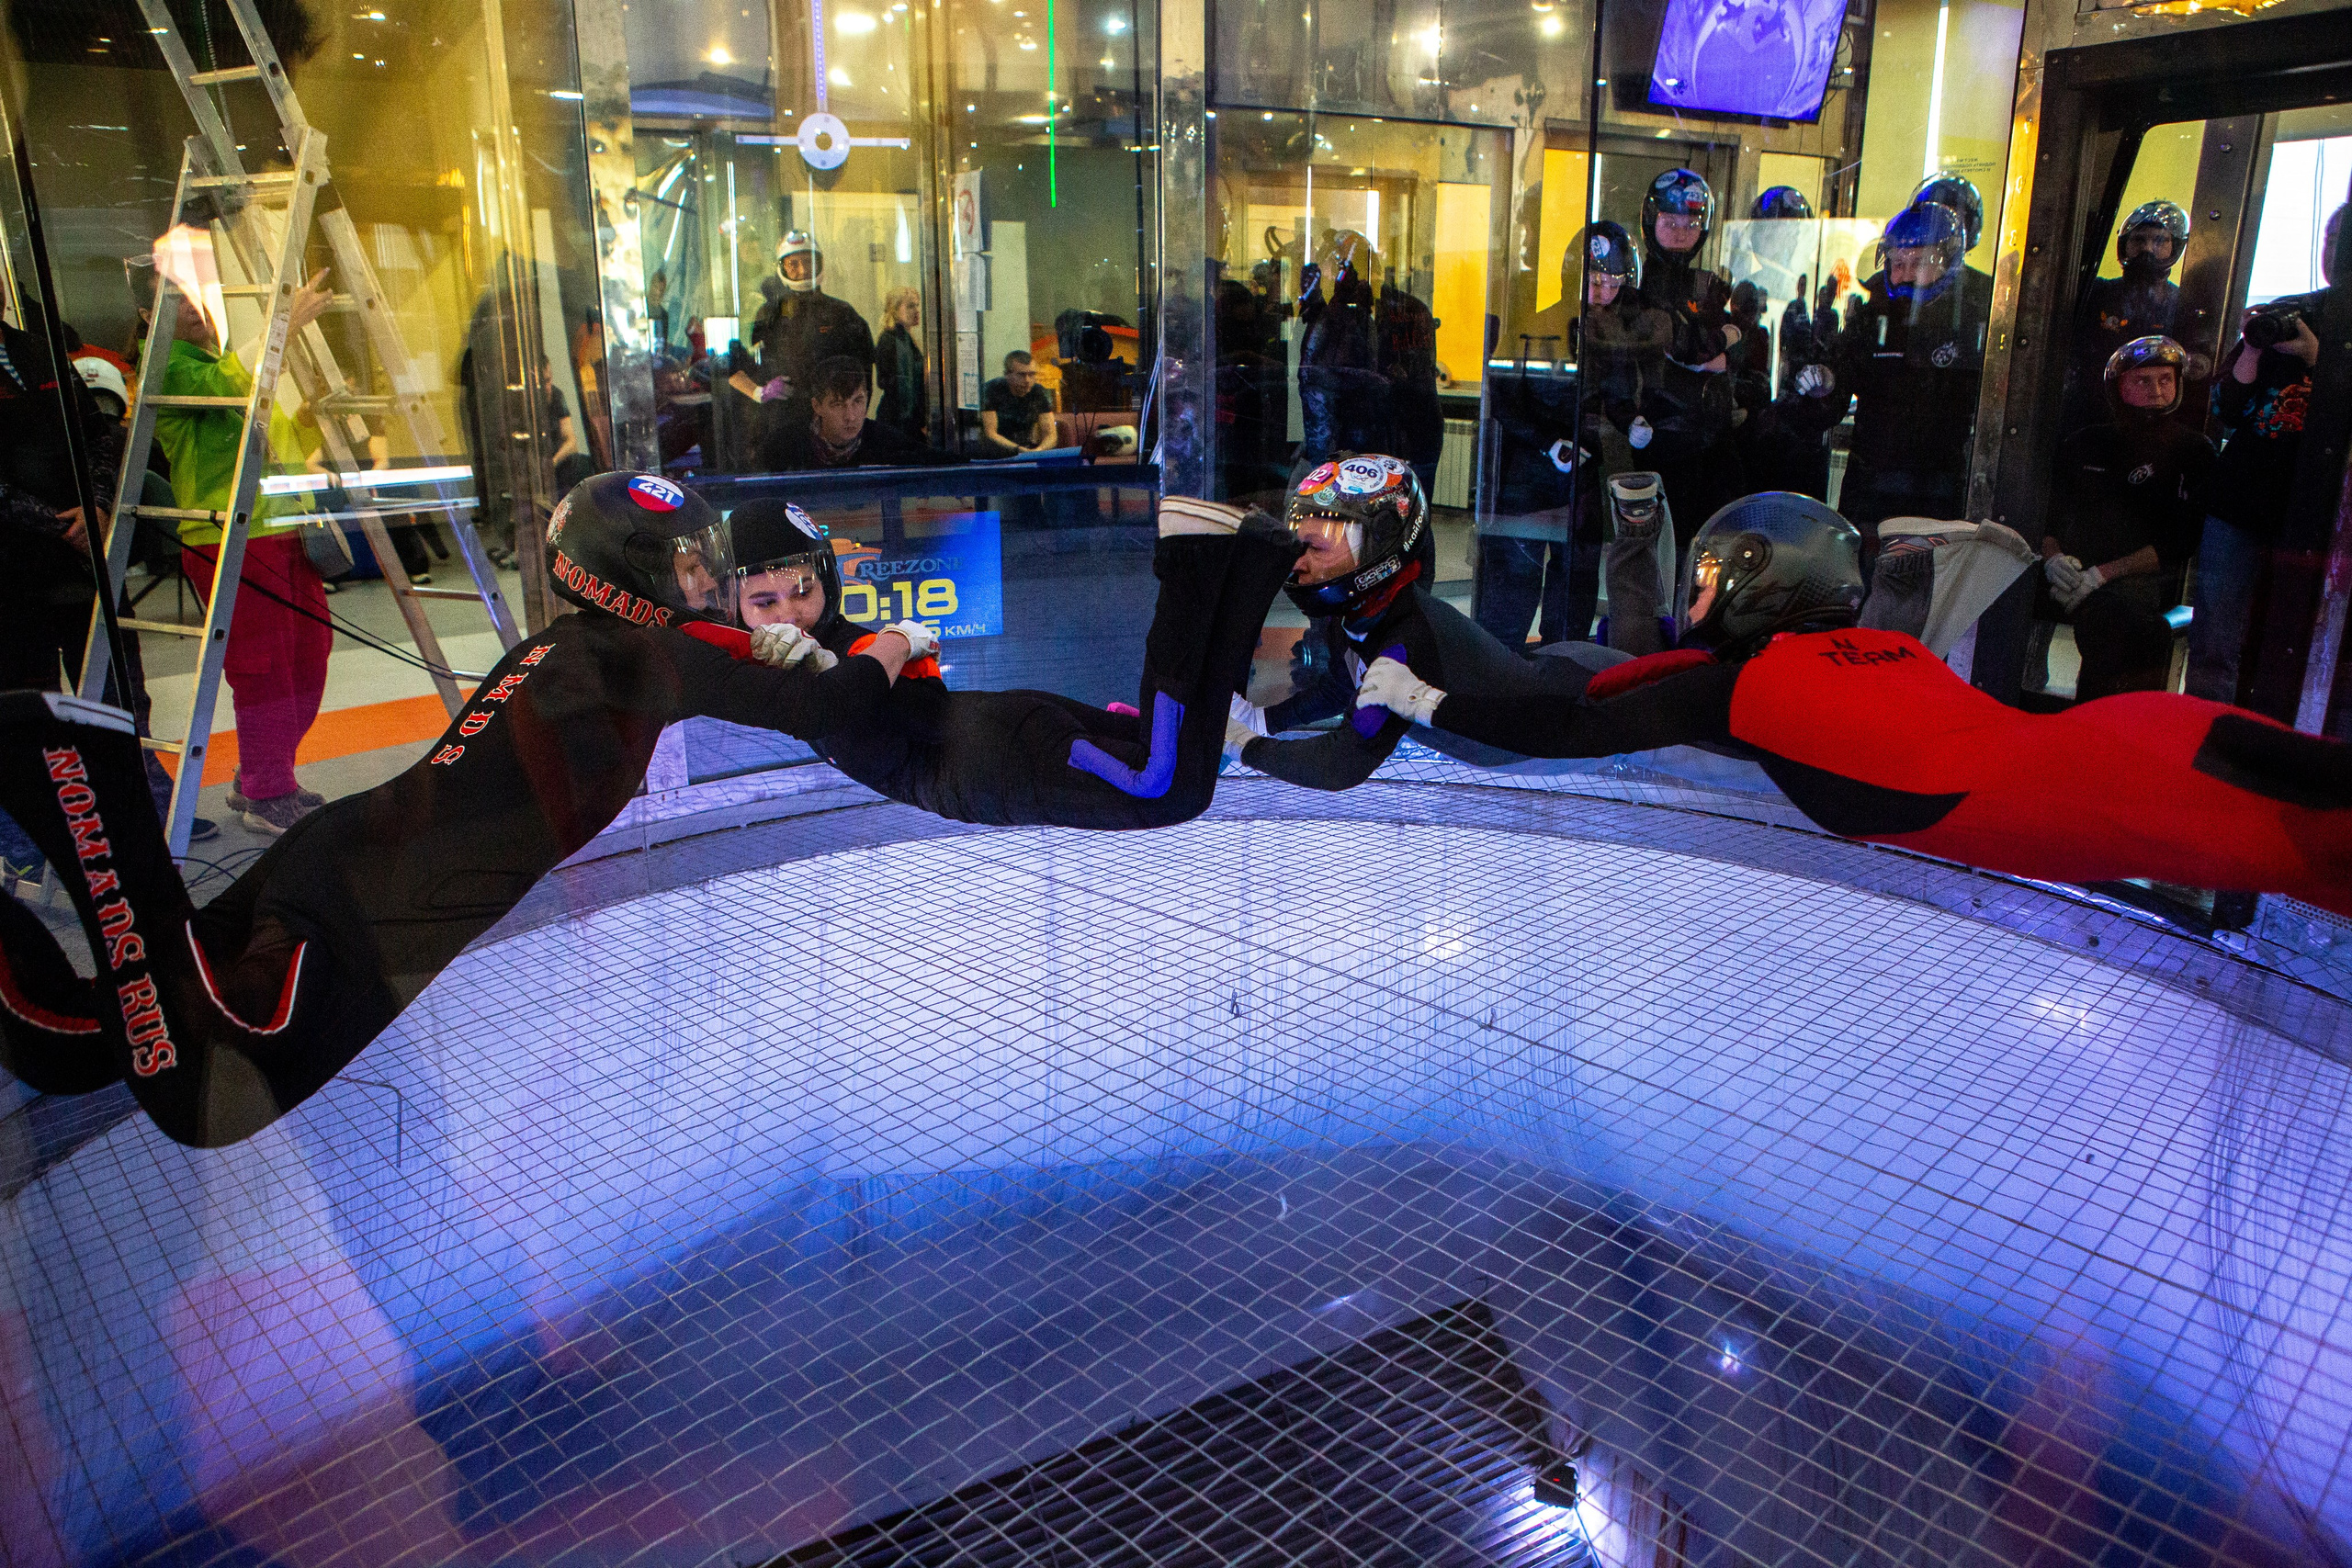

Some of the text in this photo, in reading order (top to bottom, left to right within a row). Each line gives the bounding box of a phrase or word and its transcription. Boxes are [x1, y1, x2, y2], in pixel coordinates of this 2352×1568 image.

[1344, 464, 1378, 479] 406
[637, 480, 675, 503] 421
[553, 549, 674, 628] NOMADS
[1818, 646, 1917, 667] TEAM
[42, 745, 178, 1078] NOMADS RUS
